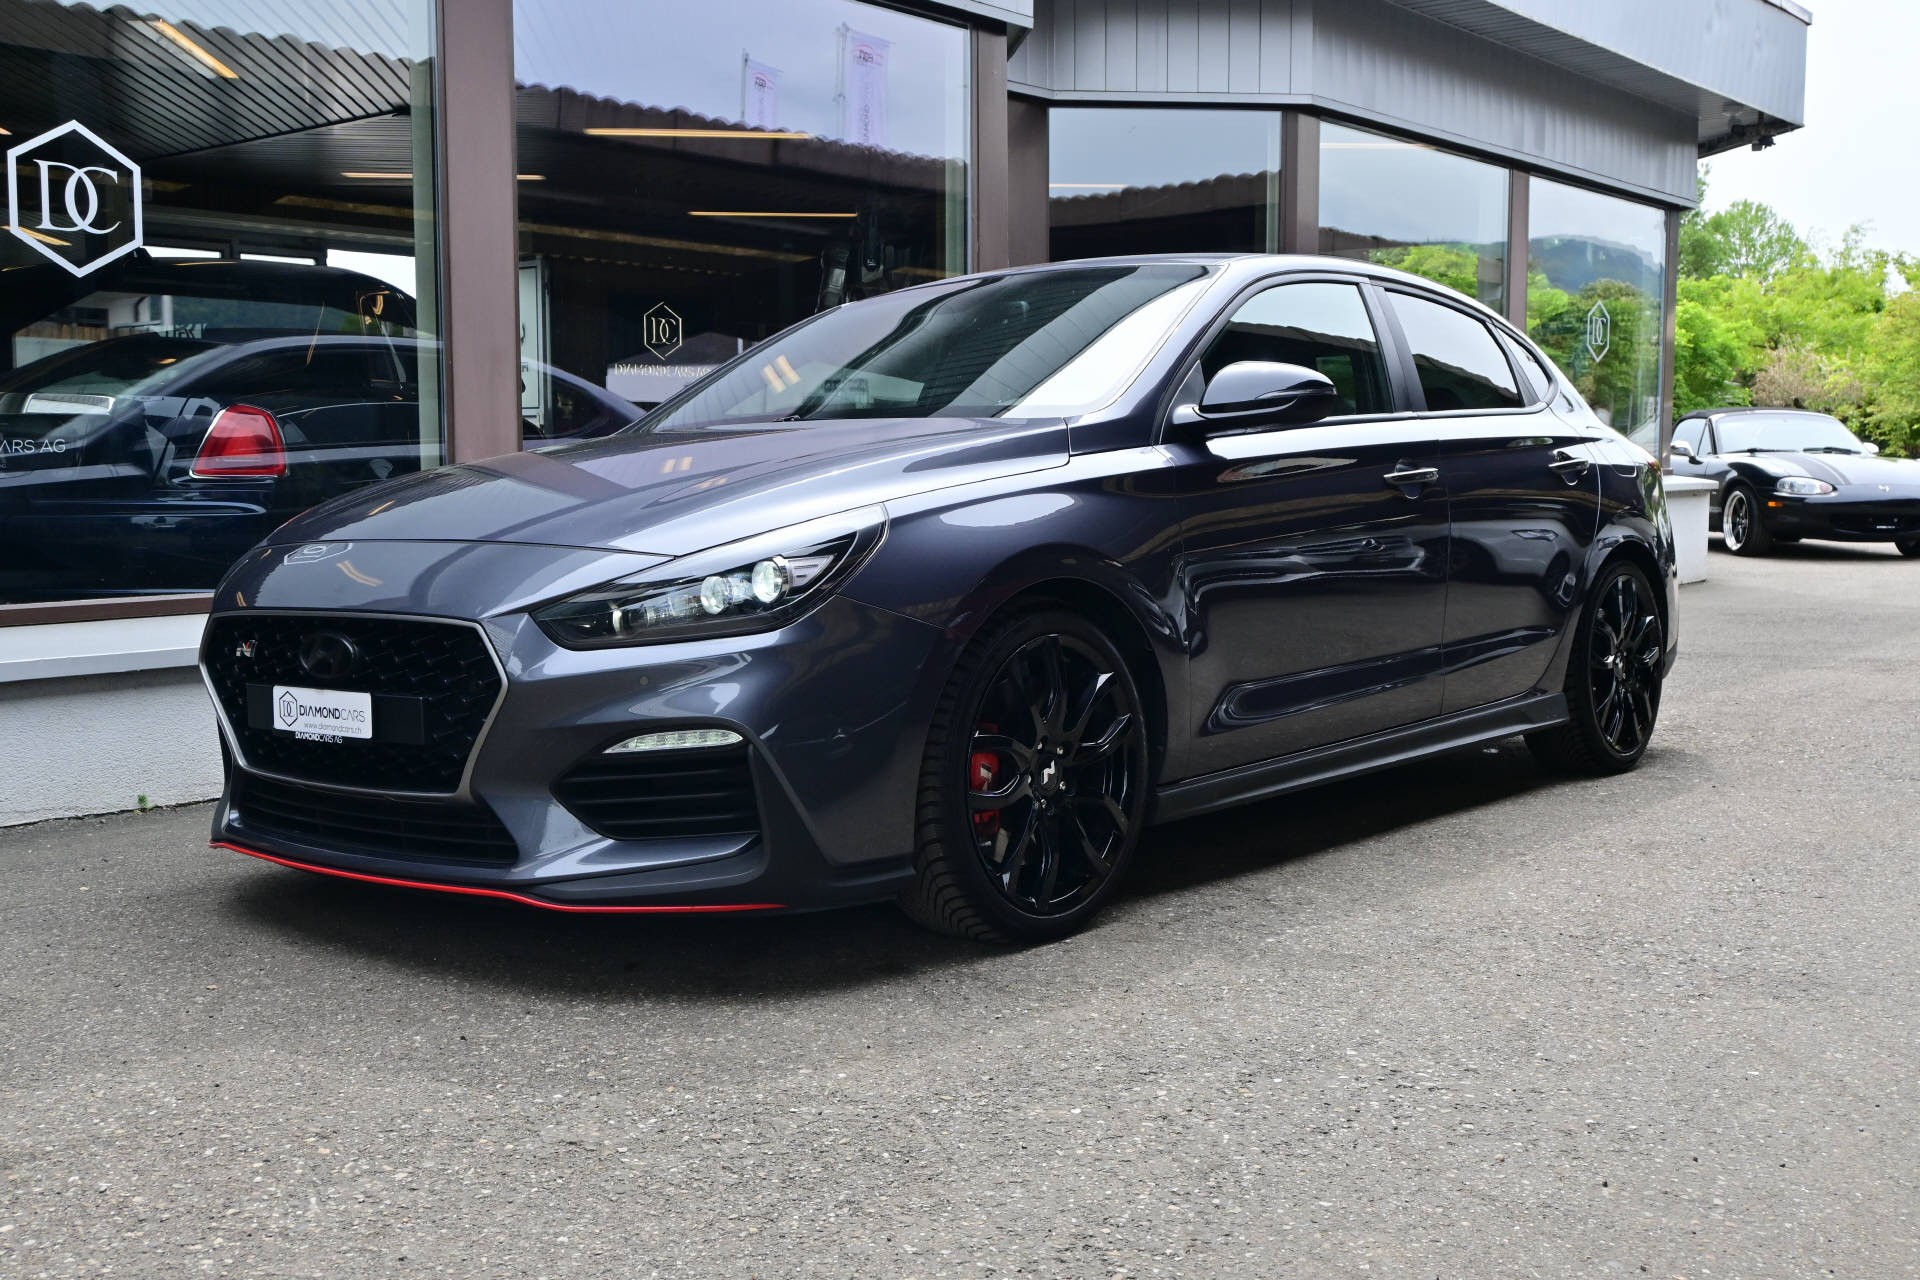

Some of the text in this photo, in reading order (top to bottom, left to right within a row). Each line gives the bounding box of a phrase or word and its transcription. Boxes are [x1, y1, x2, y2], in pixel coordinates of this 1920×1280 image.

[33, 159, 122, 234] DC
[651, 316, 677, 345] DC
[40, 439, 66, 453] AG
[299, 704, 366, 723] DIAMONDCARS
[304, 721, 362, 735] www.diamondcars.ch
